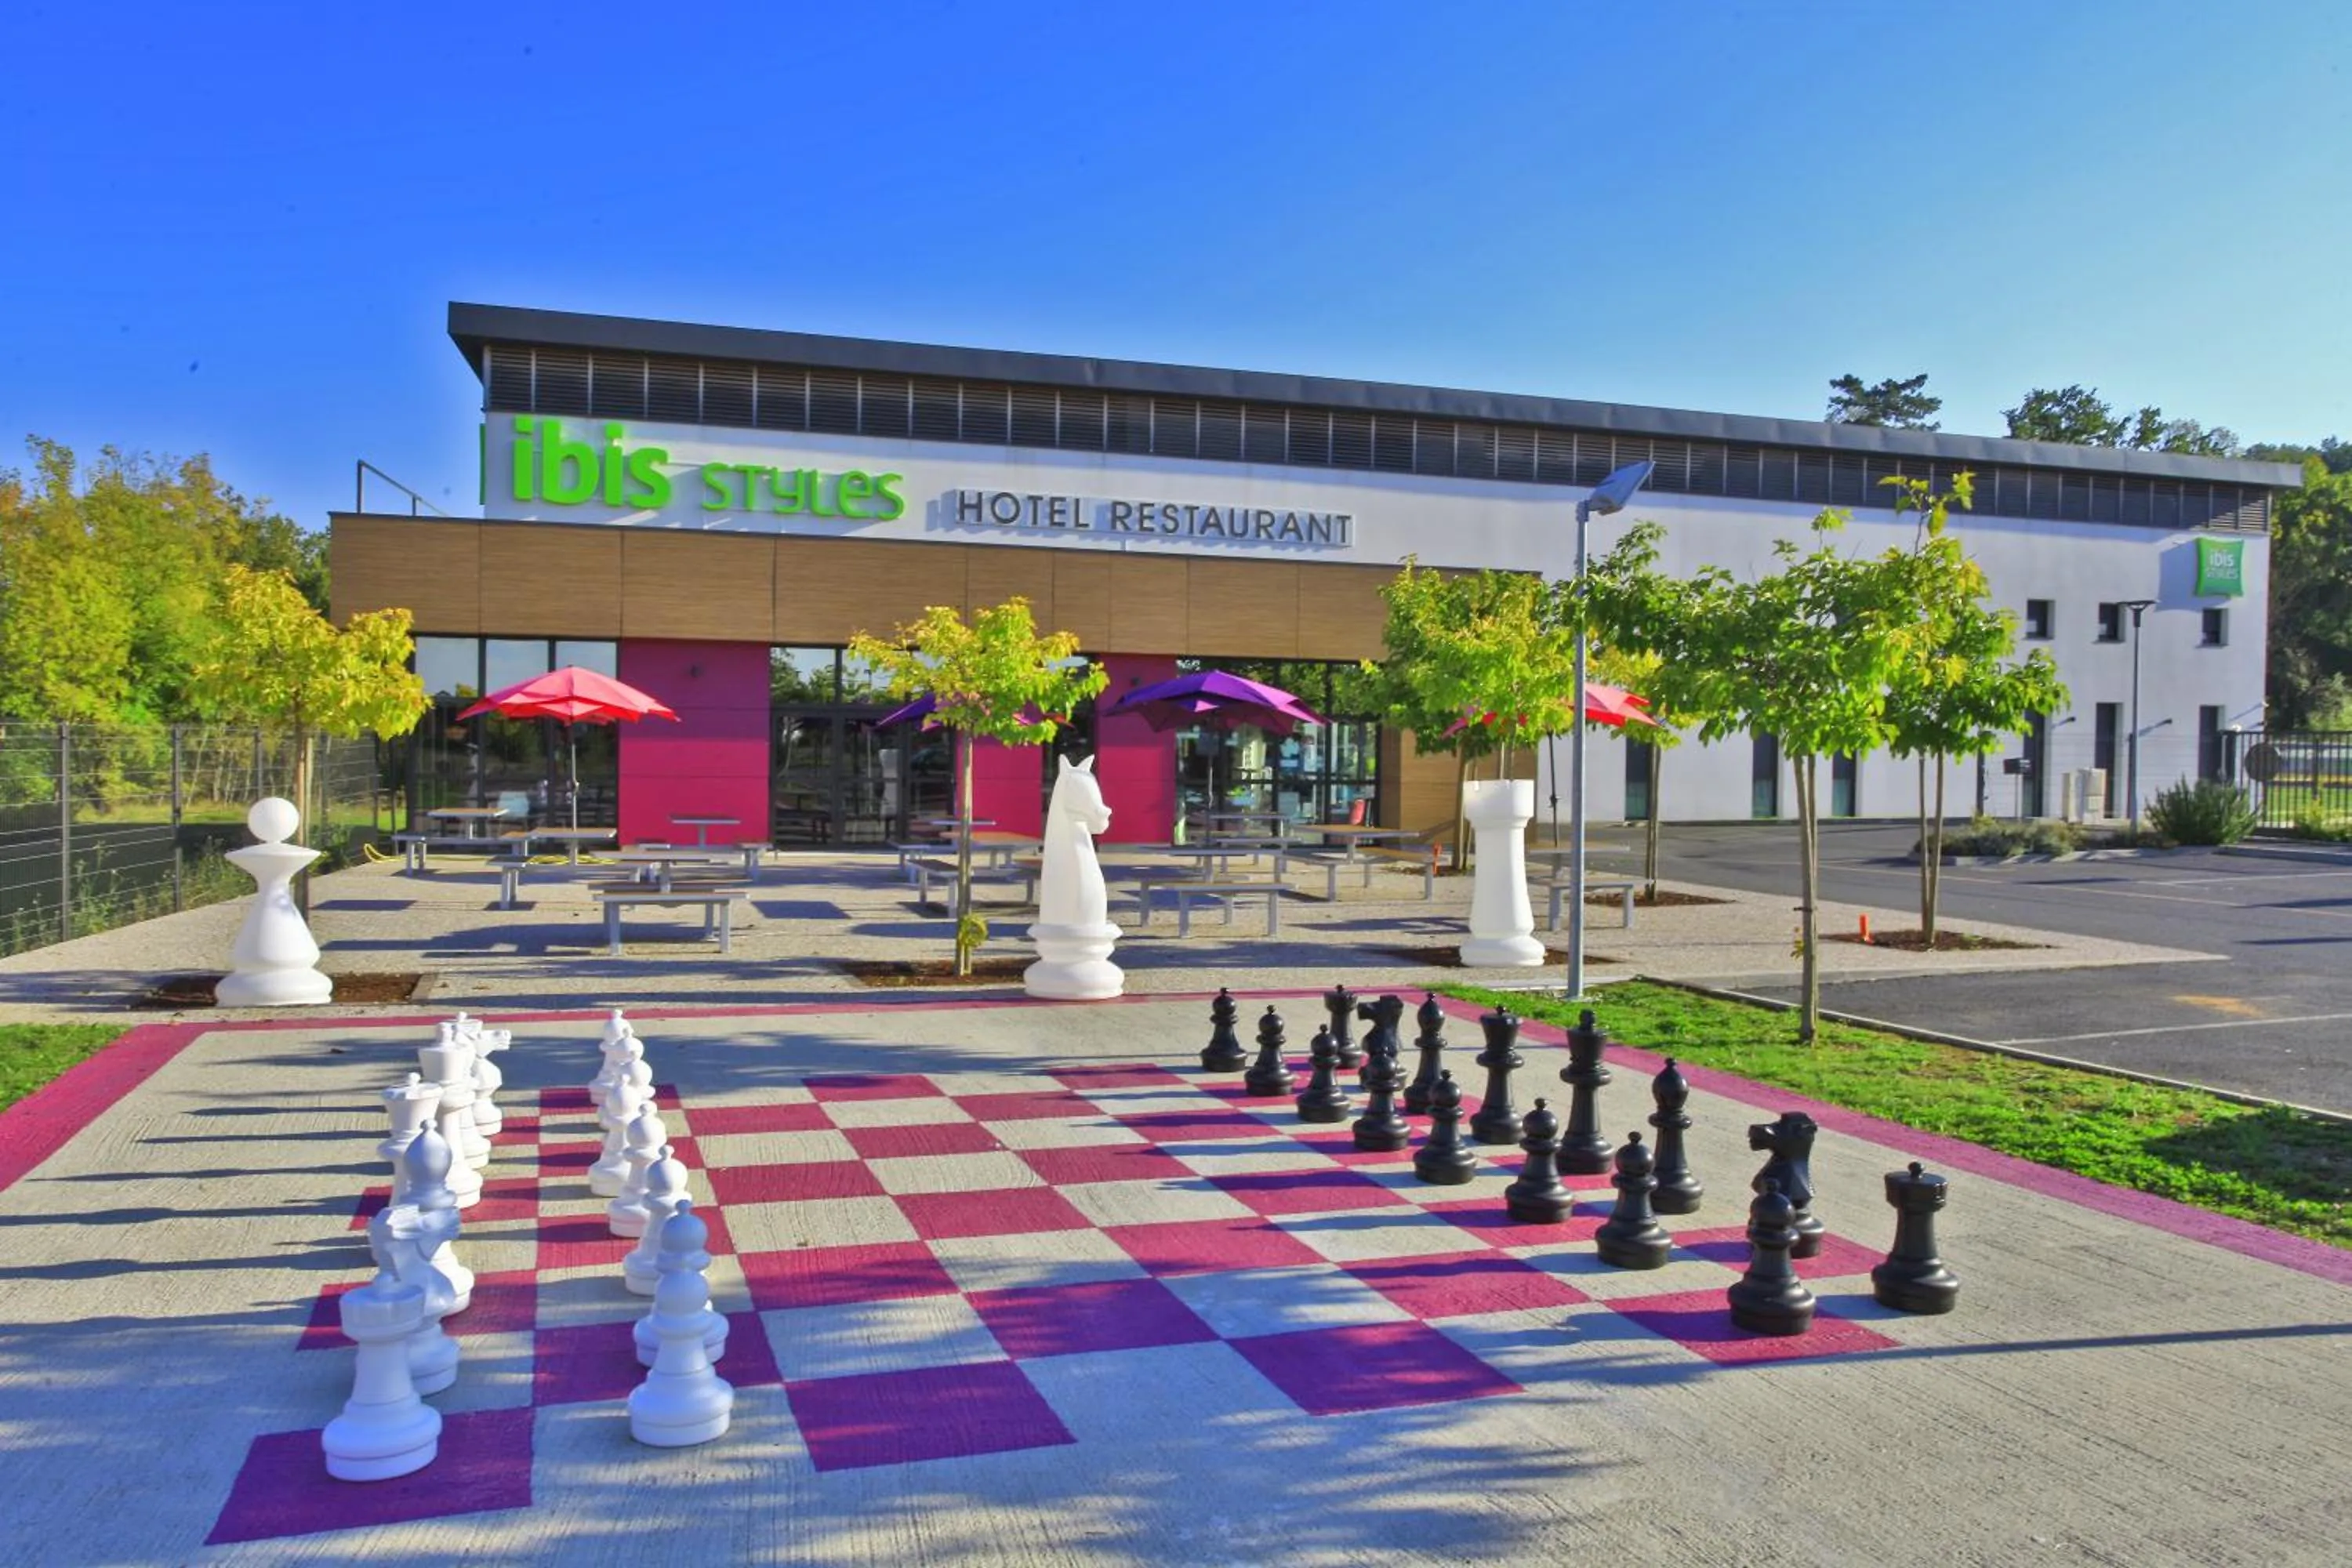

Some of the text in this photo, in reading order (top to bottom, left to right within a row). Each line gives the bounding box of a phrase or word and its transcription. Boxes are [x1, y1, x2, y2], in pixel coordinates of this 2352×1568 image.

[513, 414, 672, 509] ibis
[958, 491, 1352, 543] HOTEL RESTAURANT
